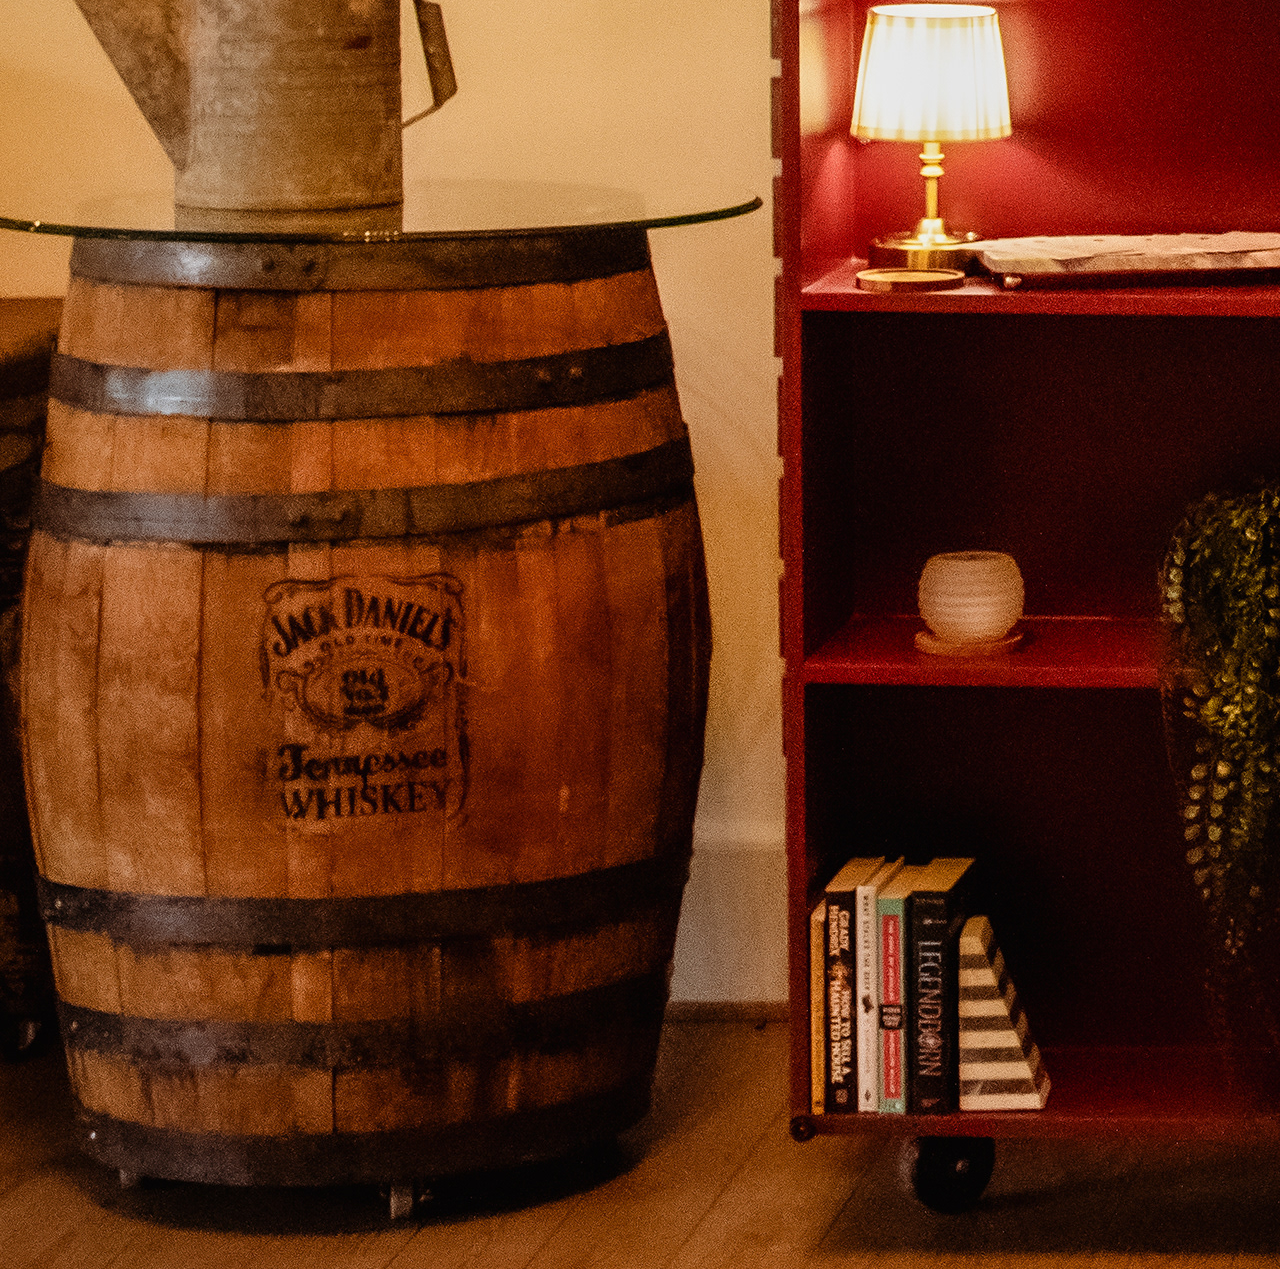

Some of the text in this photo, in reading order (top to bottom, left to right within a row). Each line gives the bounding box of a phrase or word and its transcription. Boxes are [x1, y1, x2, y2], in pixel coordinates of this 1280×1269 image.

[271, 605, 341, 658] JACK
[278, 743, 448, 782] Tennessee
[280, 781, 448, 820] WHISKEY
[839, 910, 850, 951] GRADY
[917, 939, 942, 1076] LEGENDBORN
[829, 980, 844, 1085] HAUNTED HOUSE
[840, 1021, 851, 1038] TO
[840, 1039, 852, 1065] SELL
